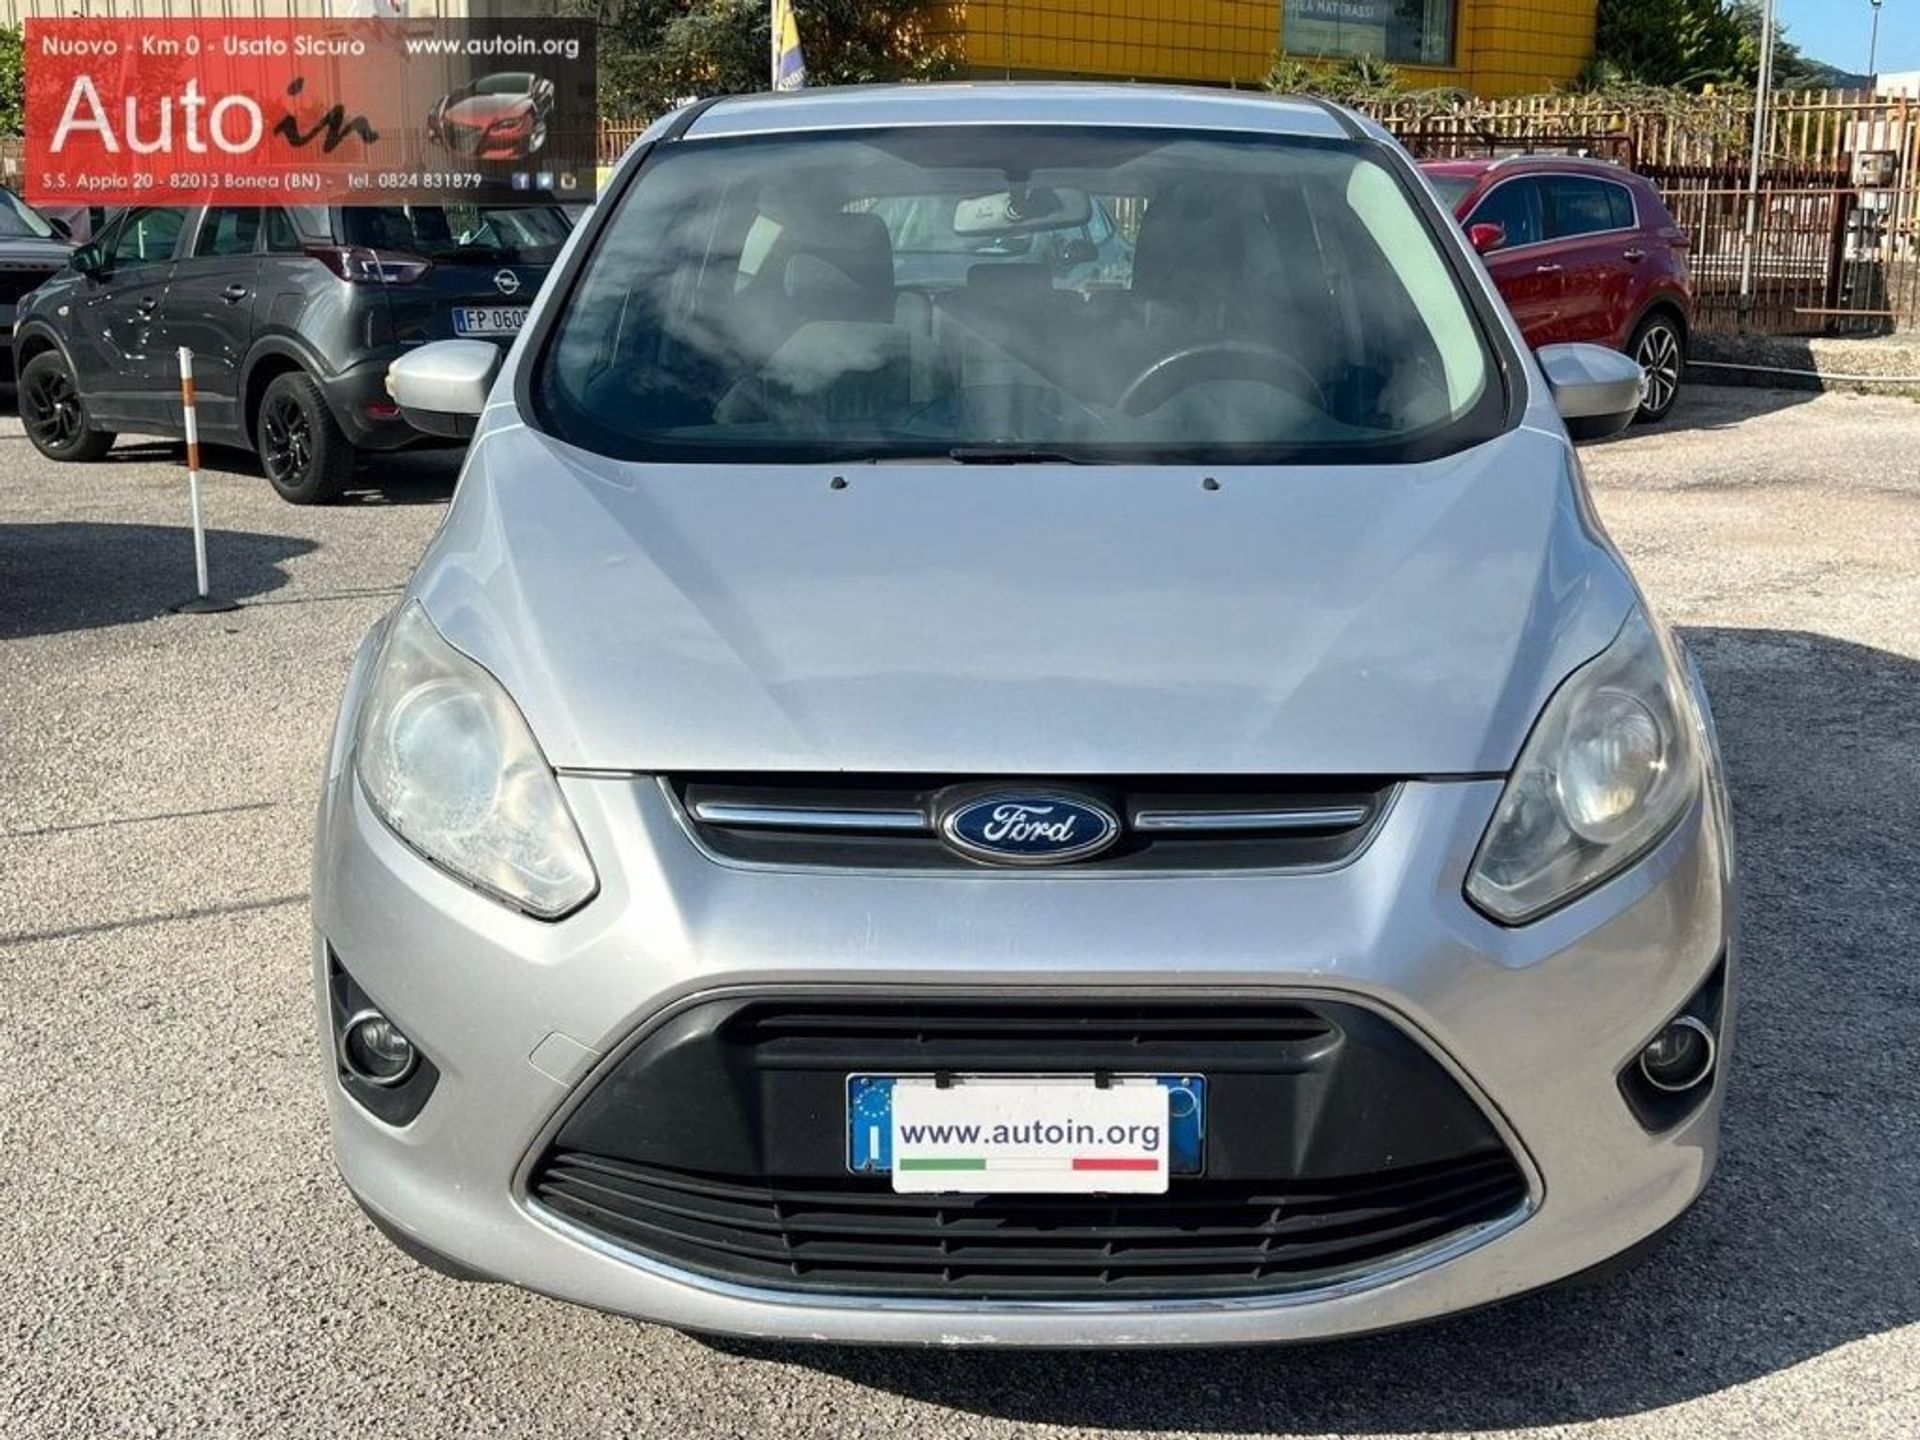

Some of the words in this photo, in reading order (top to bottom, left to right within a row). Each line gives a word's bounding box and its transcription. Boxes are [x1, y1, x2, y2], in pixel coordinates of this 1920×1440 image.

[466, 311, 487, 329] FP
[983, 804, 1077, 842] Ford
[900, 1119, 1160, 1150] www.autoin.org
